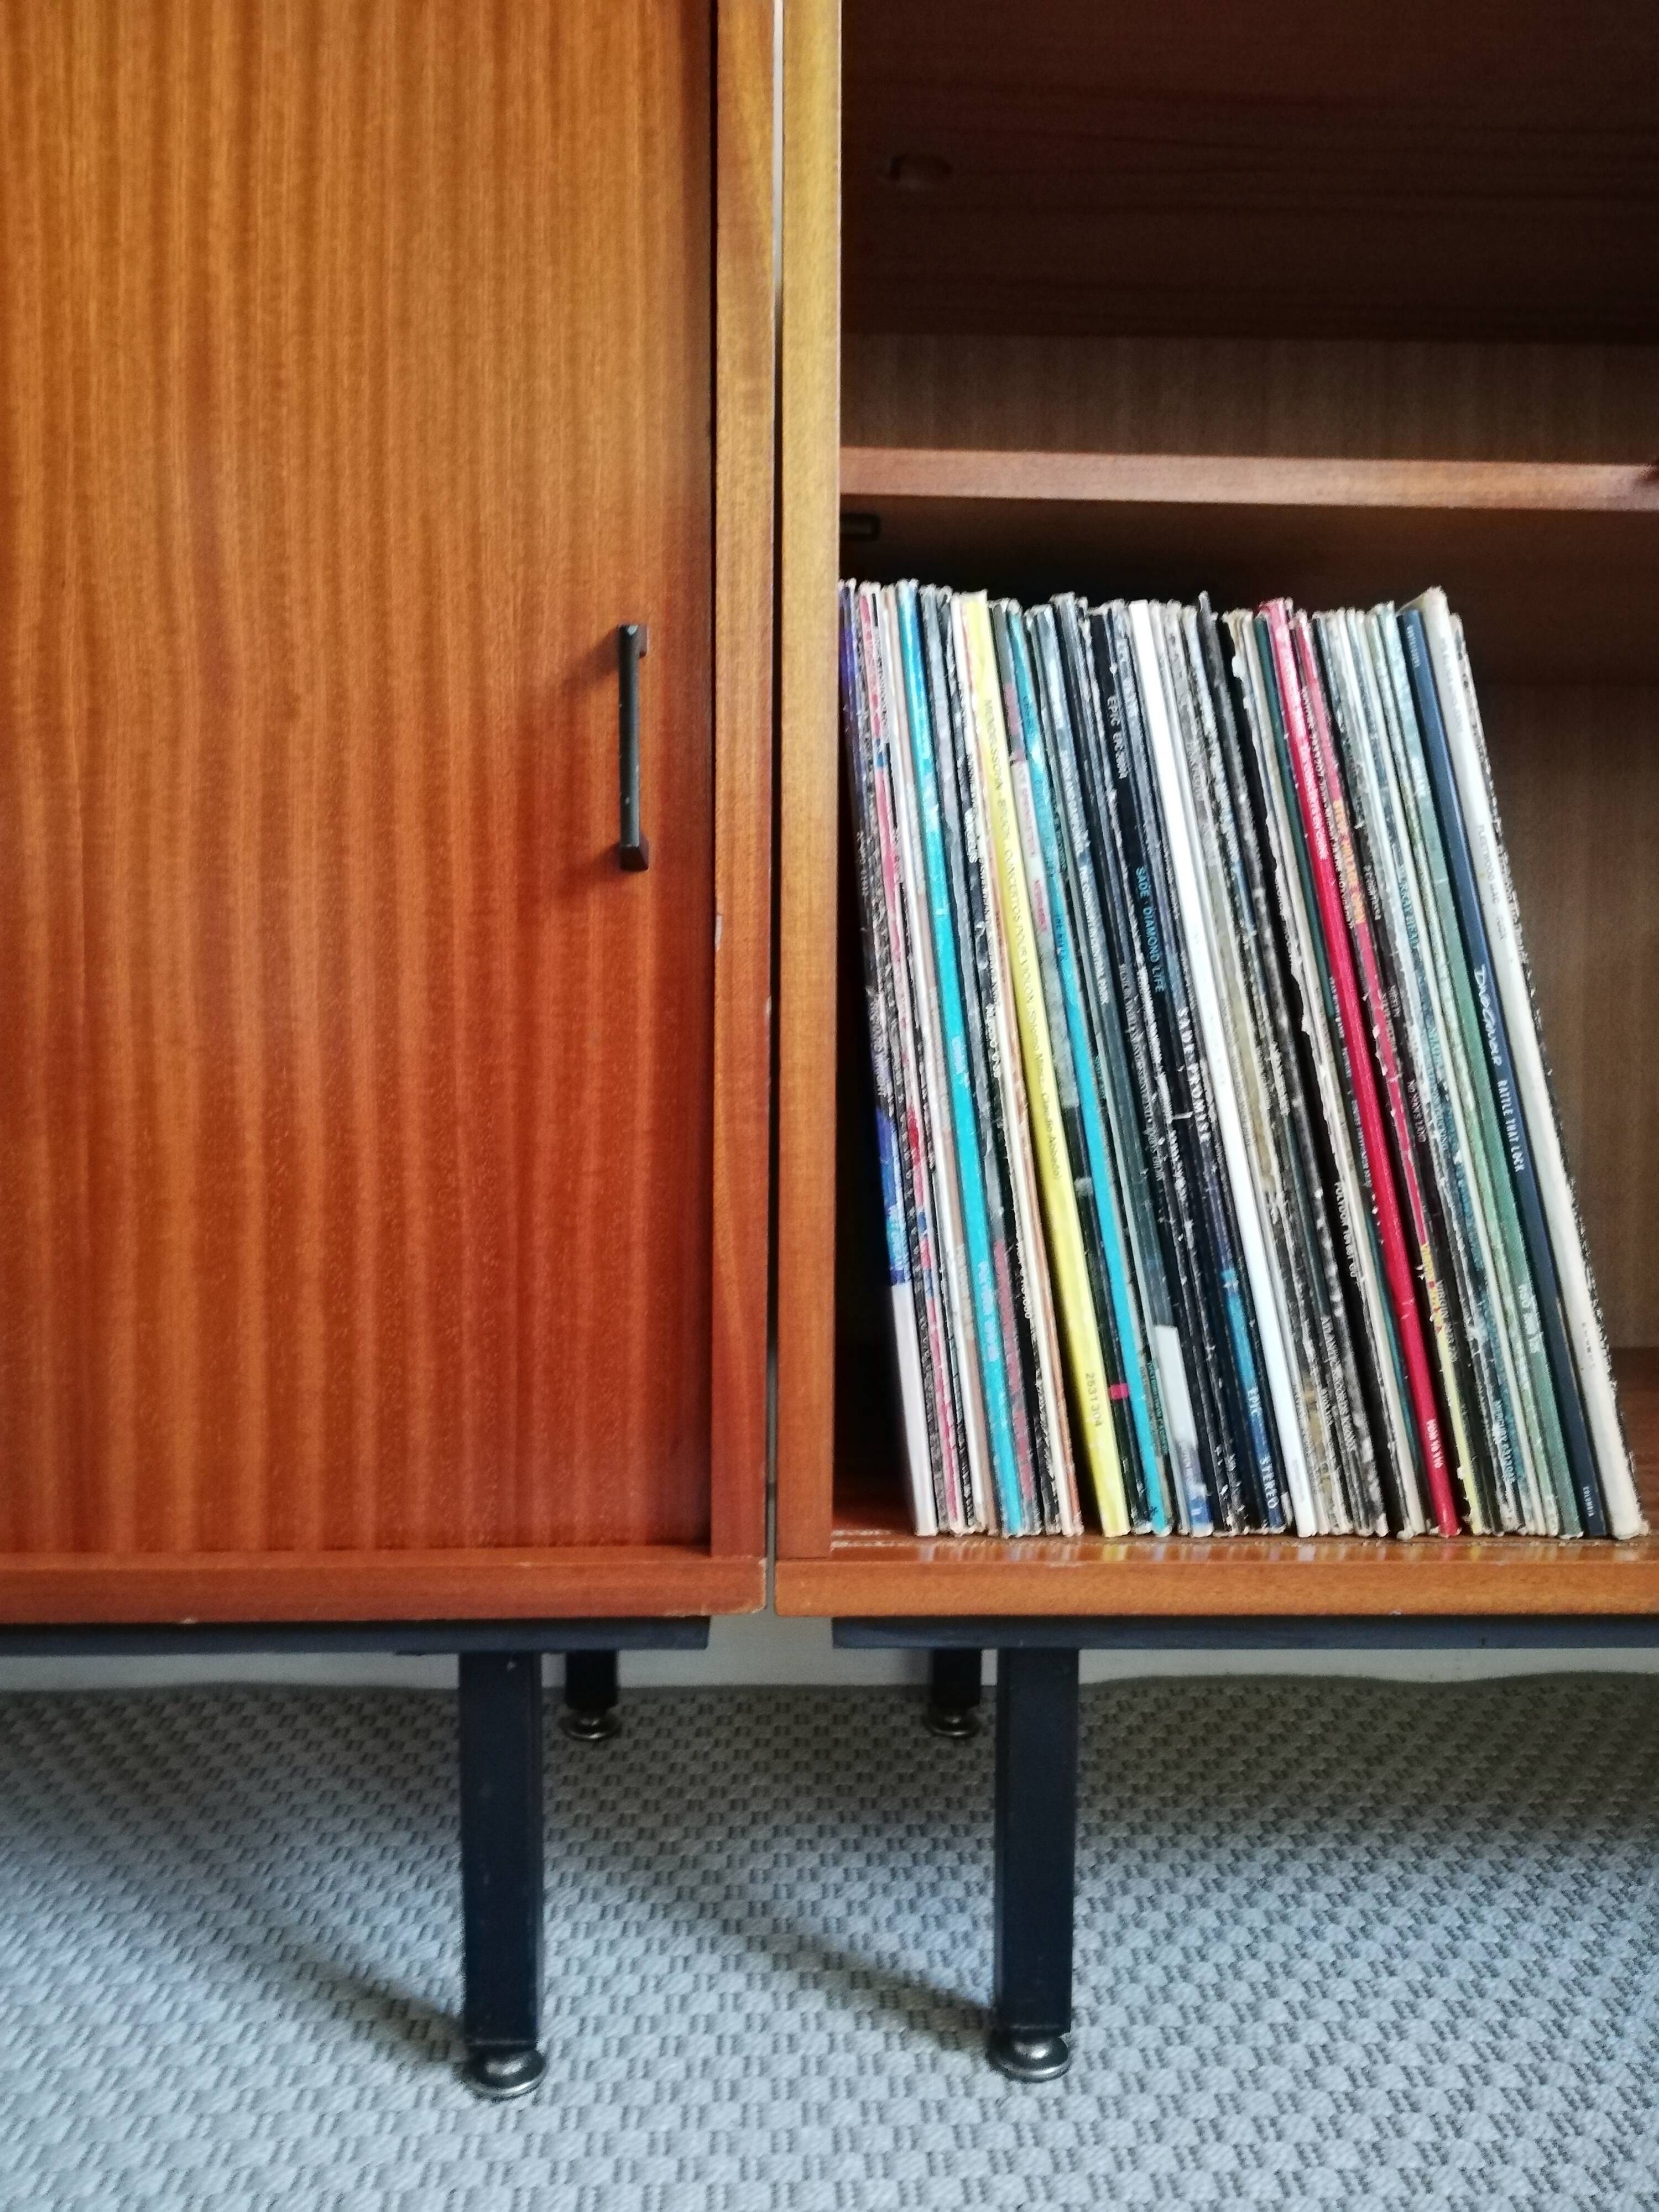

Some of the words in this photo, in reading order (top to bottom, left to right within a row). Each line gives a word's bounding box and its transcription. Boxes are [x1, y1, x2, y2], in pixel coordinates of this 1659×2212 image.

[1106, 695, 1122, 726] EPIC
[982, 698, 1005, 791] MENDELSSOHN
[1332, 799, 1348, 836] STEVE
[1339, 838, 1359, 888] HILLAGE
[1003, 848, 1022, 922] CONCERTOS
[1135, 866, 1152, 899] SADE
[1014, 924, 1027, 957] POUR
[1142, 906, 1163, 962] DIAMOND
[1019, 959, 1035, 1004] VIOLON
[1097, 978, 1110, 1005] PARK
[1151, 966, 1167, 993] LIFE
[1176, 1005, 1196, 1053] SADE
[1186, 1062, 1212, 1142] PROMISE
[1040, 1092, 1055, 1133] Claudio
[1495, 1078, 1516, 1117] RATTLE
[1503, 1118, 1521, 1144] THAT
[1509, 1144, 1527, 1172] LOCK
[1084, 1371, 1098, 1402] 2531
[1245, 1386, 1262, 1416] EPIC
[1090, 1404, 1103, 1427] 304
[1258, 1454, 1279, 1509] STEREO
[1581, 1485, 1596, 1517] COLUMBIA
